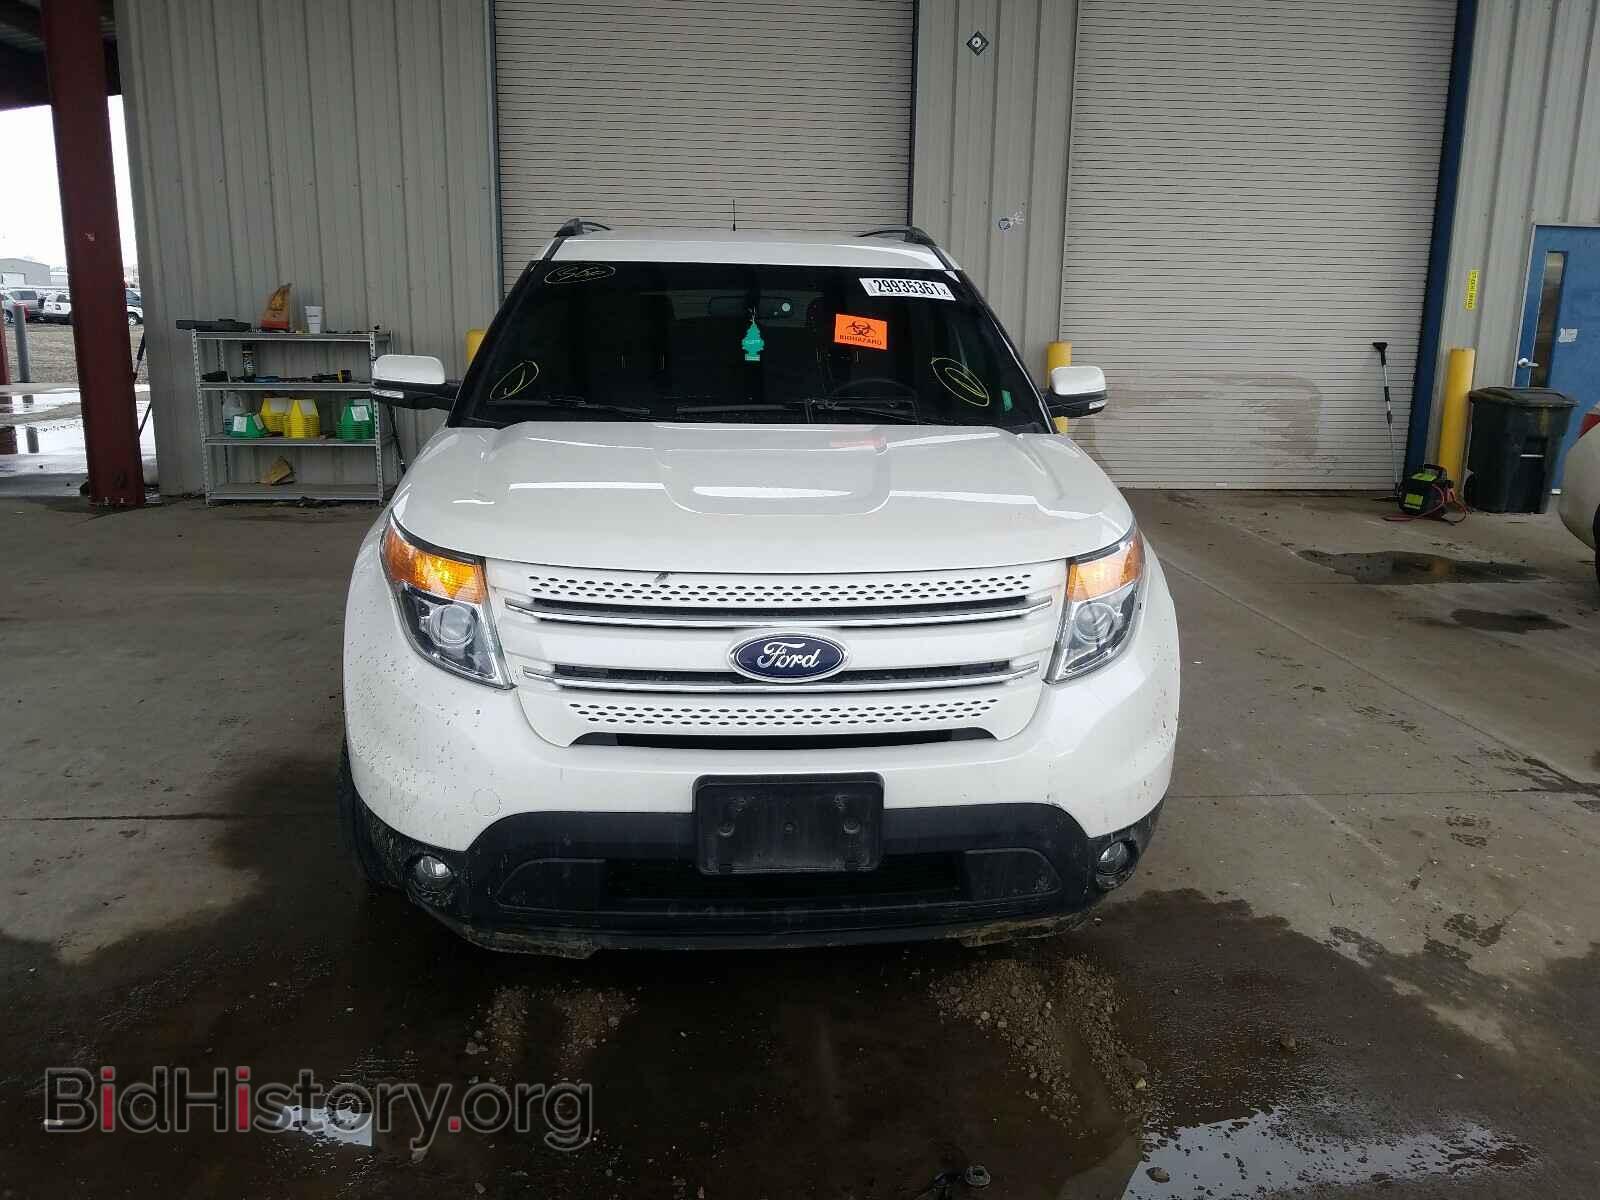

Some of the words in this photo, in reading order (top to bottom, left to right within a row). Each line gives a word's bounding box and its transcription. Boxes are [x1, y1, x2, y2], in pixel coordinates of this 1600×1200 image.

[873, 279, 941, 295] 29935361
[839, 334, 882, 345] BIOHAZARD
[757, 641, 821, 668] Ford
